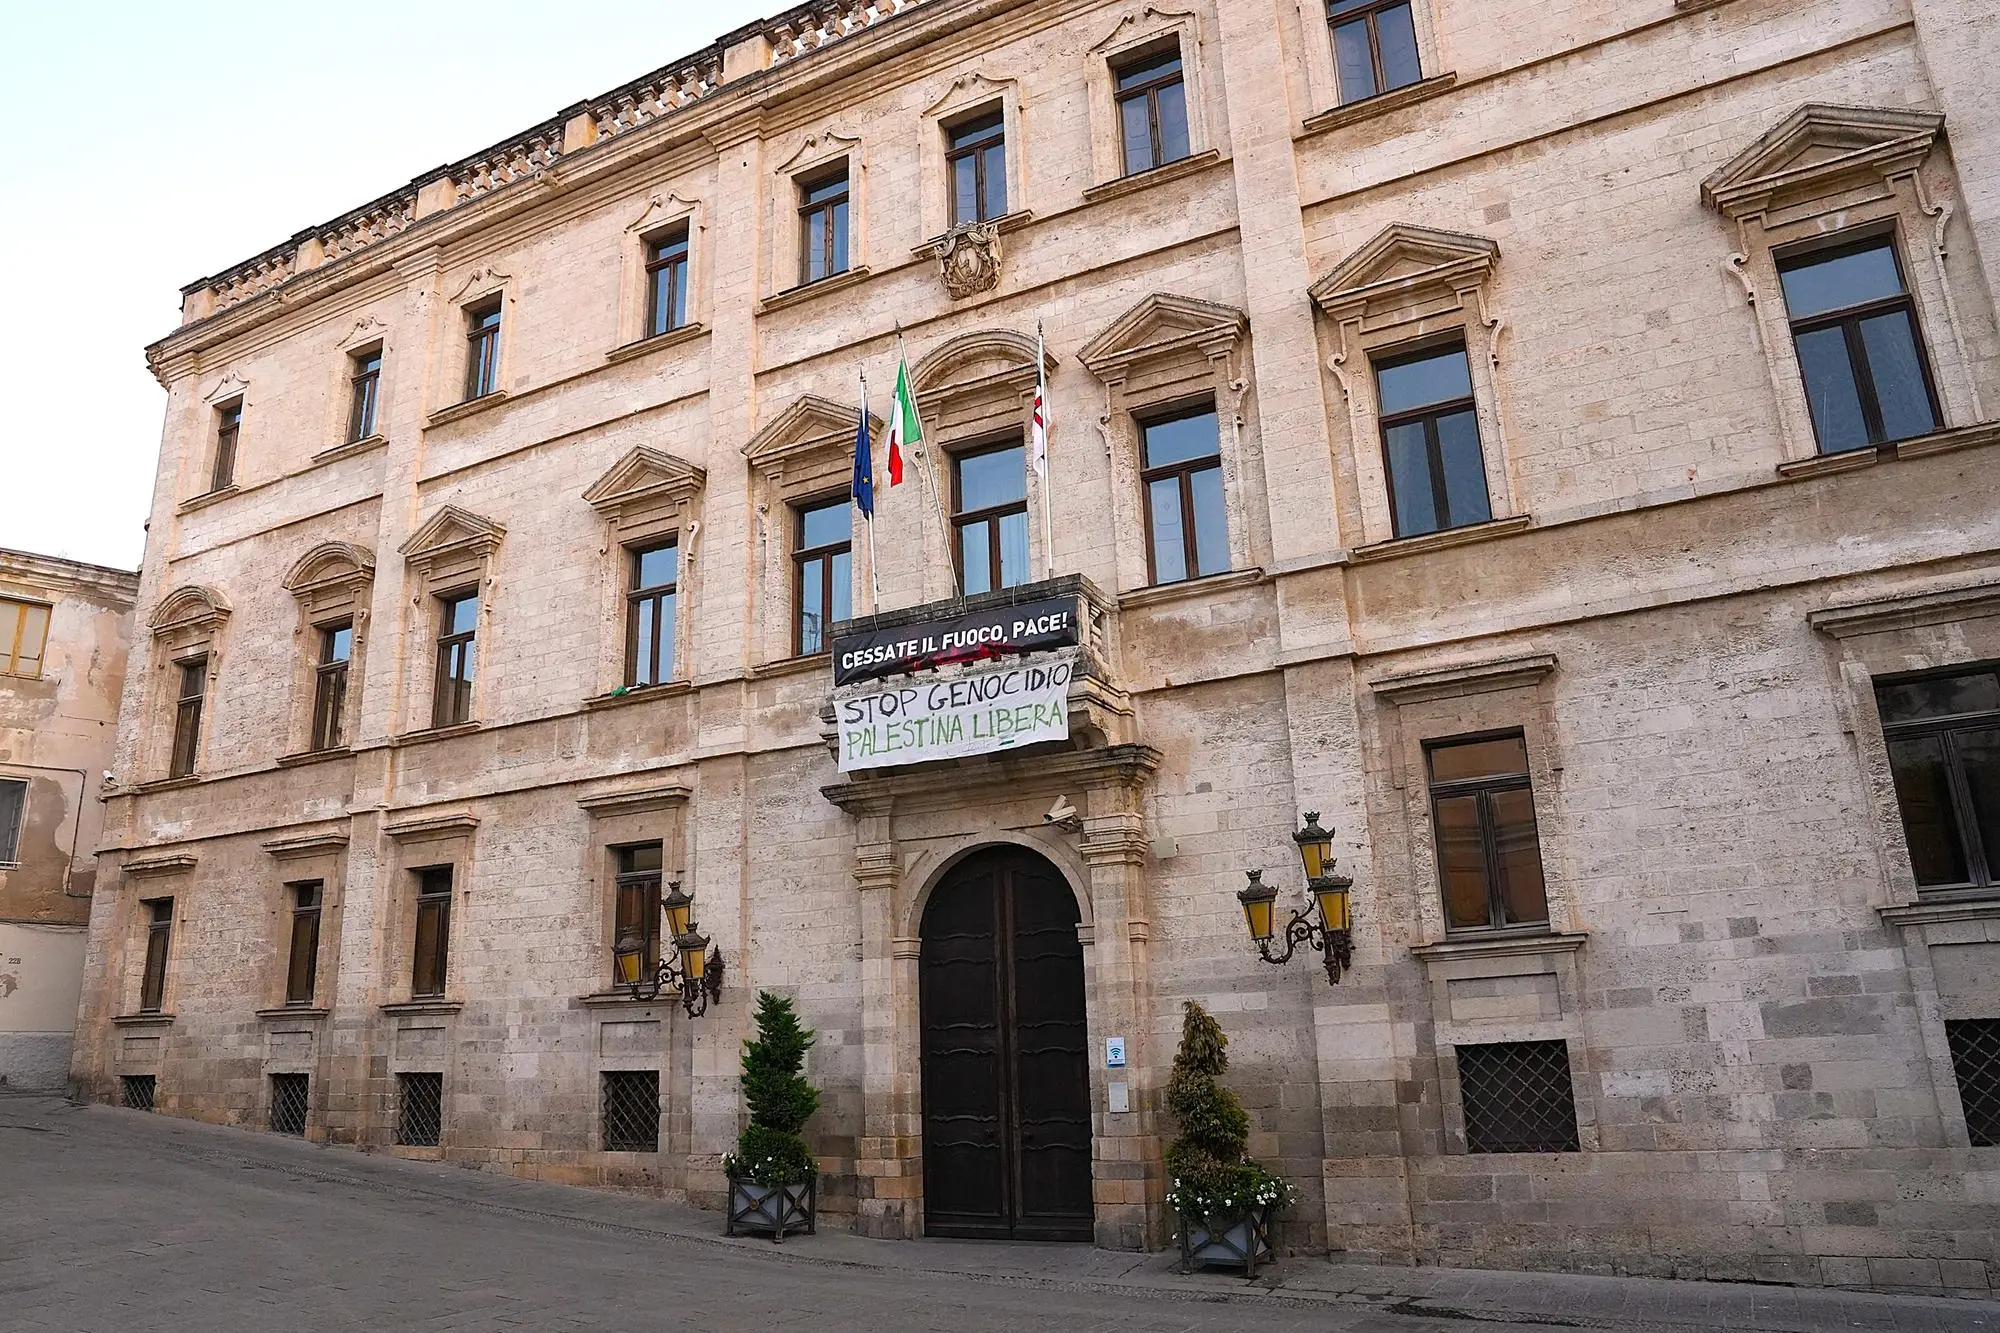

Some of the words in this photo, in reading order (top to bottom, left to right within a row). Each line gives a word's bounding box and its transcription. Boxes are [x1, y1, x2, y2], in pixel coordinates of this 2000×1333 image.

[841, 640, 918, 670] CESSATE
[921, 631, 938, 653] IL
[942, 624, 1008, 649] FUOCO,
[1012, 612, 1068, 639] PACE!
[844, 688, 918, 724] STOP
[928, 663, 1069, 711] GENOCIDIO
[847, 713, 964, 760] PALESTINA
[973, 700, 1063, 738] LIBERA
